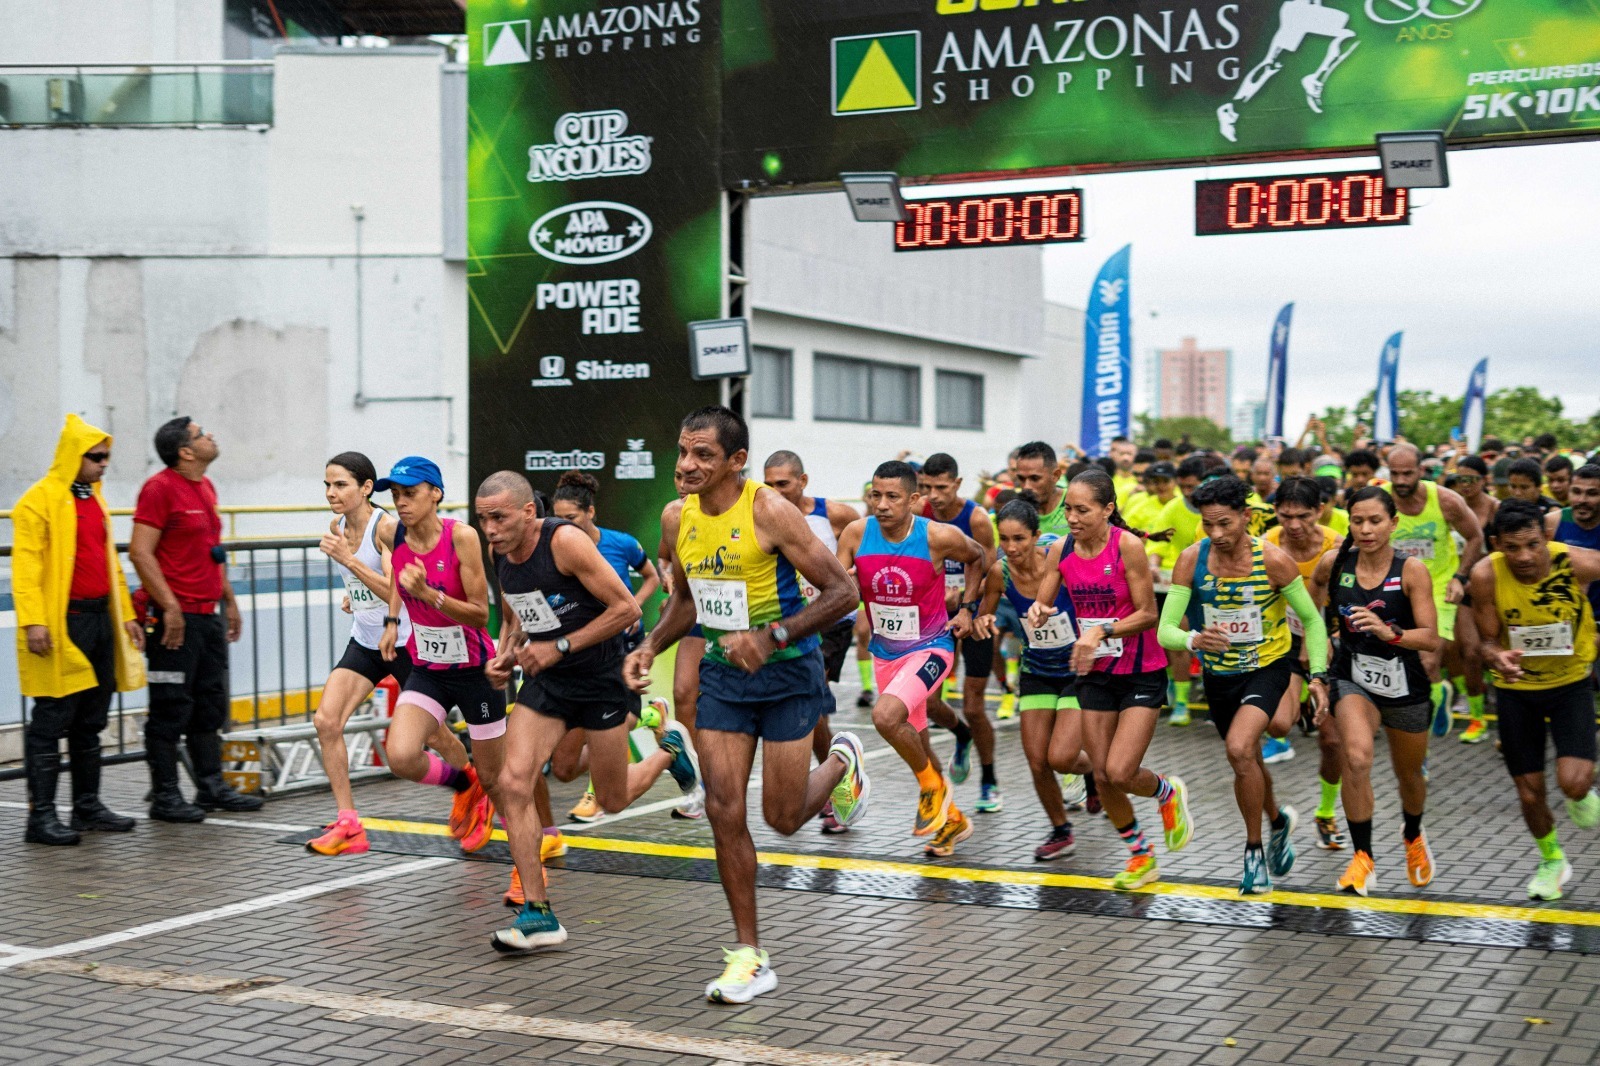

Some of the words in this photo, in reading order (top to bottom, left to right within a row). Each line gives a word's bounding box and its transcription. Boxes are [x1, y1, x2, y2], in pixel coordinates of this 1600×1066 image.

[537, 0, 701, 43] AMAZONAS
[932, 4, 1241, 75] AMAZONAS
[1396, 23, 1454, 43] ANOS
[536, 28, 701, 60] SHOPPING
[932, 57, 1241, 104] SHOPPING
[555, 111, 626, 147] CUP
[529, 137, 651, 181] NOODLES
[565, 210, 609, 235] APA
[536, 279, 641, 310] POWER
[582, 306, 641, 335] ADE
[576, 360, 650, 381] Shizen
[530, 452, 602, 468] mentos
[886, 584, 900, 595] CT
[699, 598, 733, 617] 1483
[880, 617, 903, 632] 787
[1033, 629, 1058, 641] 871
[423, 639, 447, 655] 797
[1523, 636, 1554, 648] 927
[1363, 669, 1391, 688] 370
